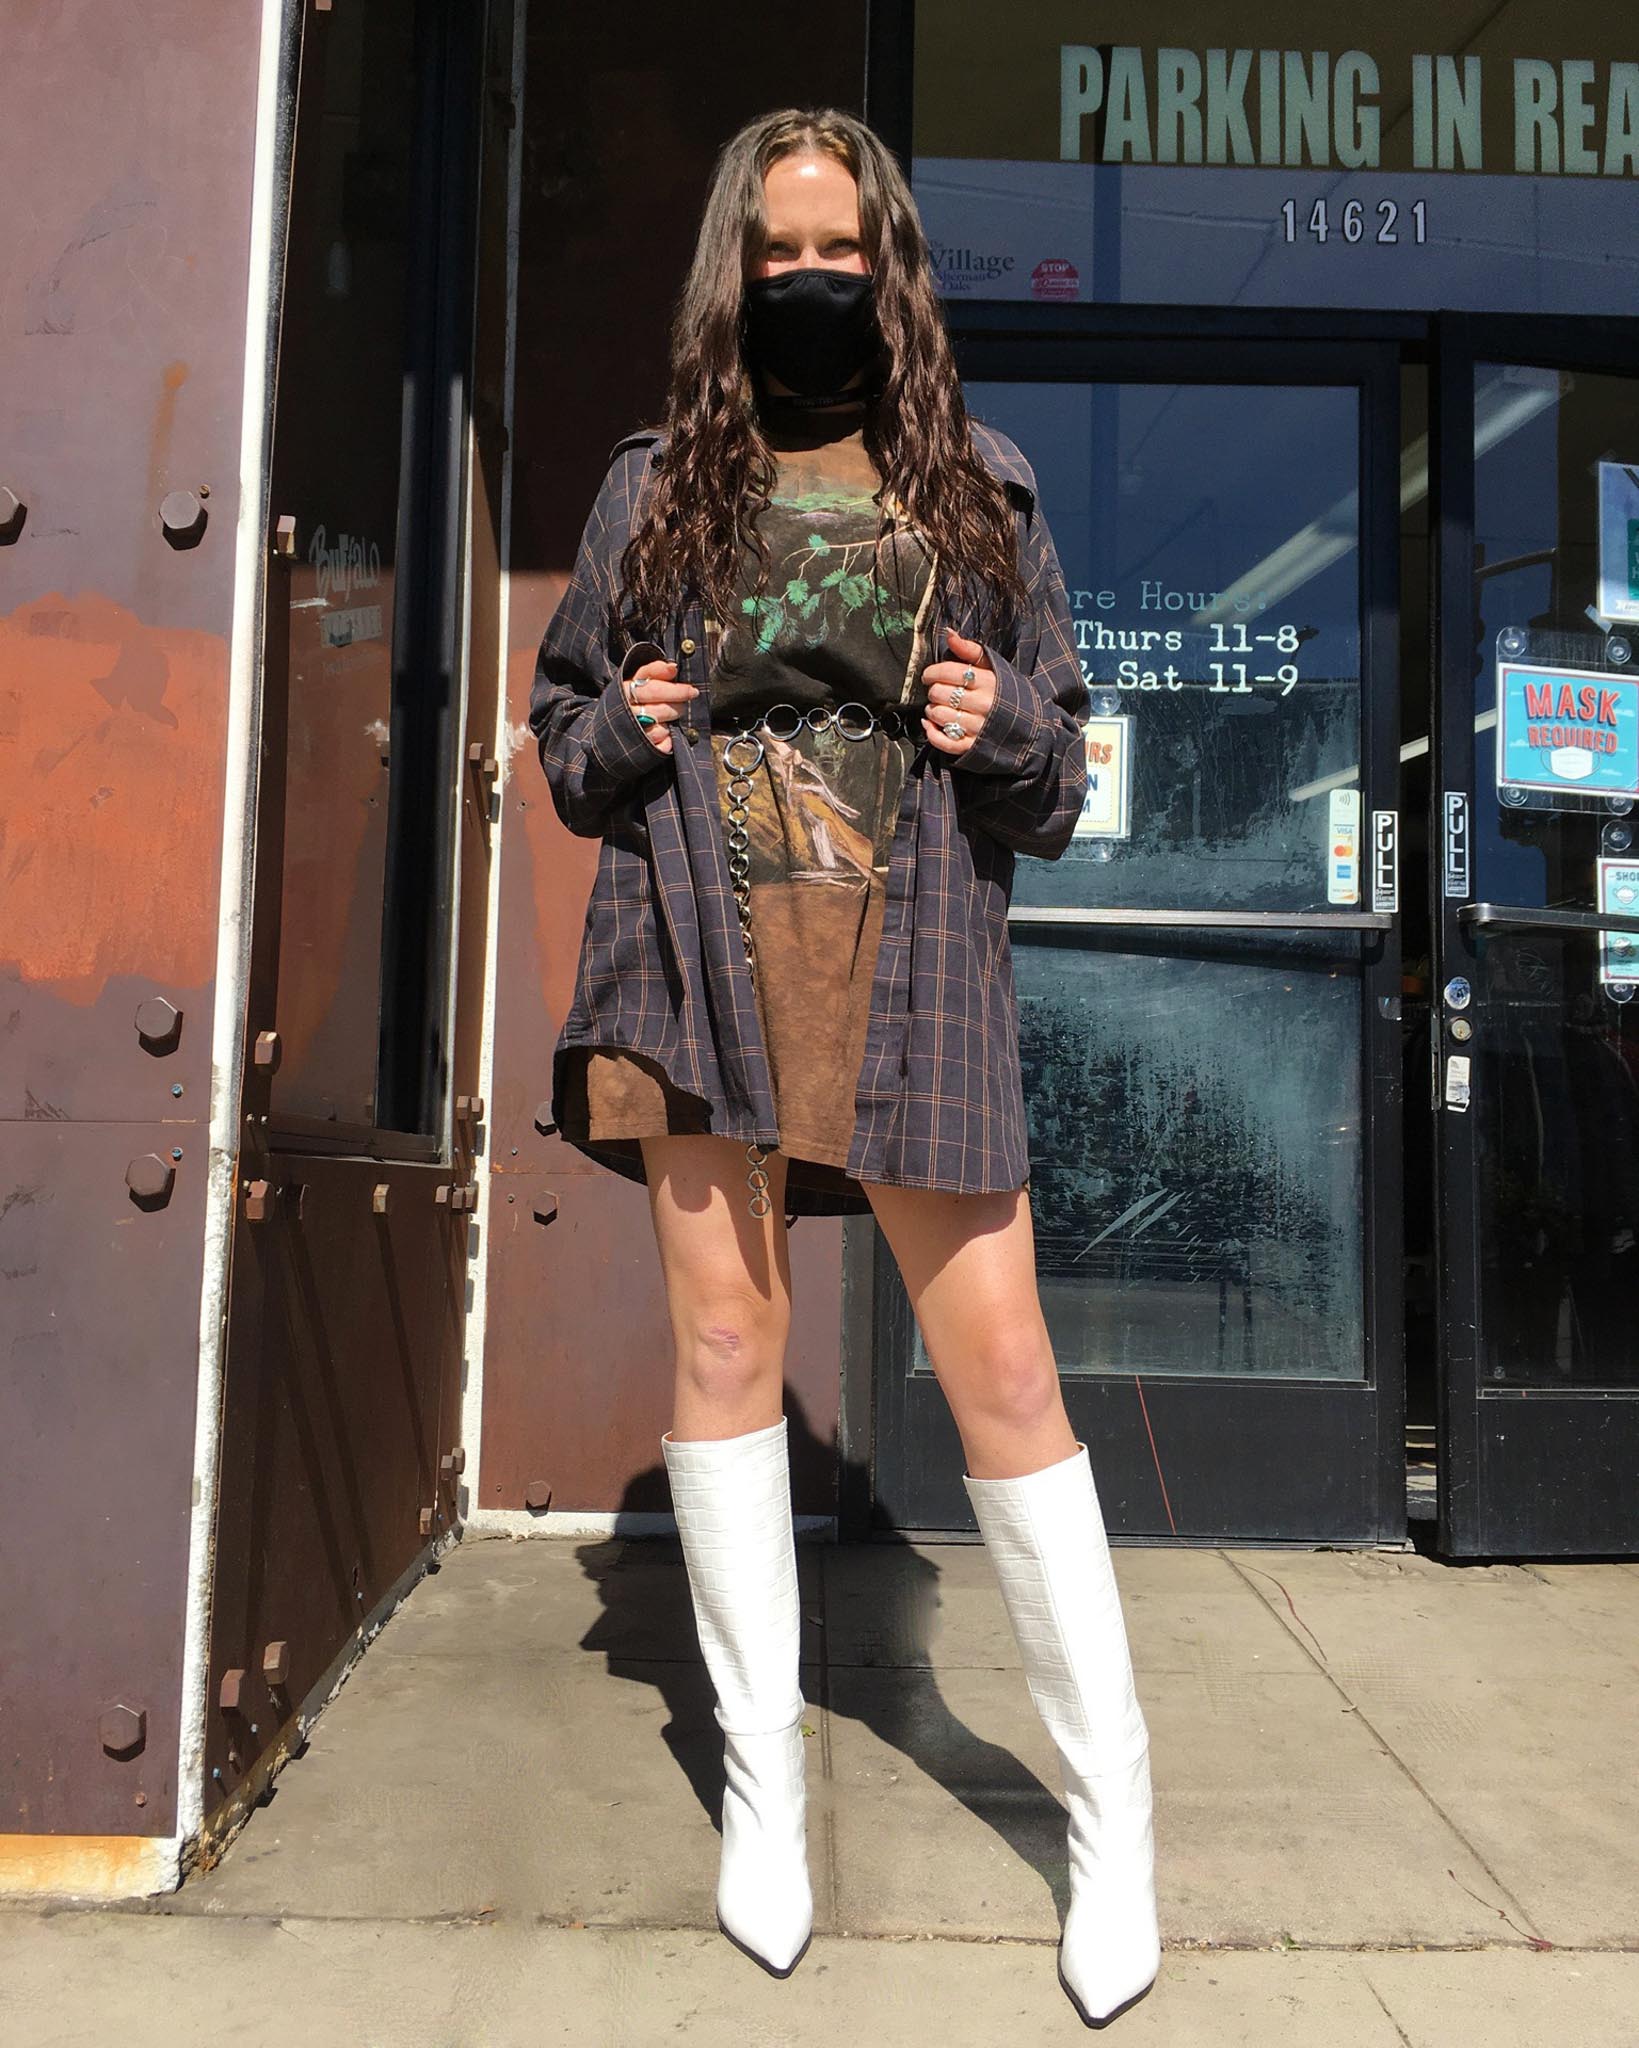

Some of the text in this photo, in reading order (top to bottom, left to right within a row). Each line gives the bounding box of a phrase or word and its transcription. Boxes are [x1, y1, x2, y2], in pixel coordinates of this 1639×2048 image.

[1060, 45, 1381, 169] PARKING
[1412, 54, 1483, 170] IN
[1281, 200, 1427, 245] 14621
[929, 248, 1015, 280] Village
[1041, 263, 1069, 273] STOP
[1065, 580, 1269, 612] re Hours:
[1074, 619, 1301, 653] Thurs 11-8
[1117, 661, 1184, 692] Sat
[1208, 663, 1300, 697] 11-9
[1524, 683, 1620, 727] MASK
[1527, 725, 1619, 755] REQUIRED
[1377, 814, 1394, 888] PULL
[1449, 796, 1465, 873] PULL
